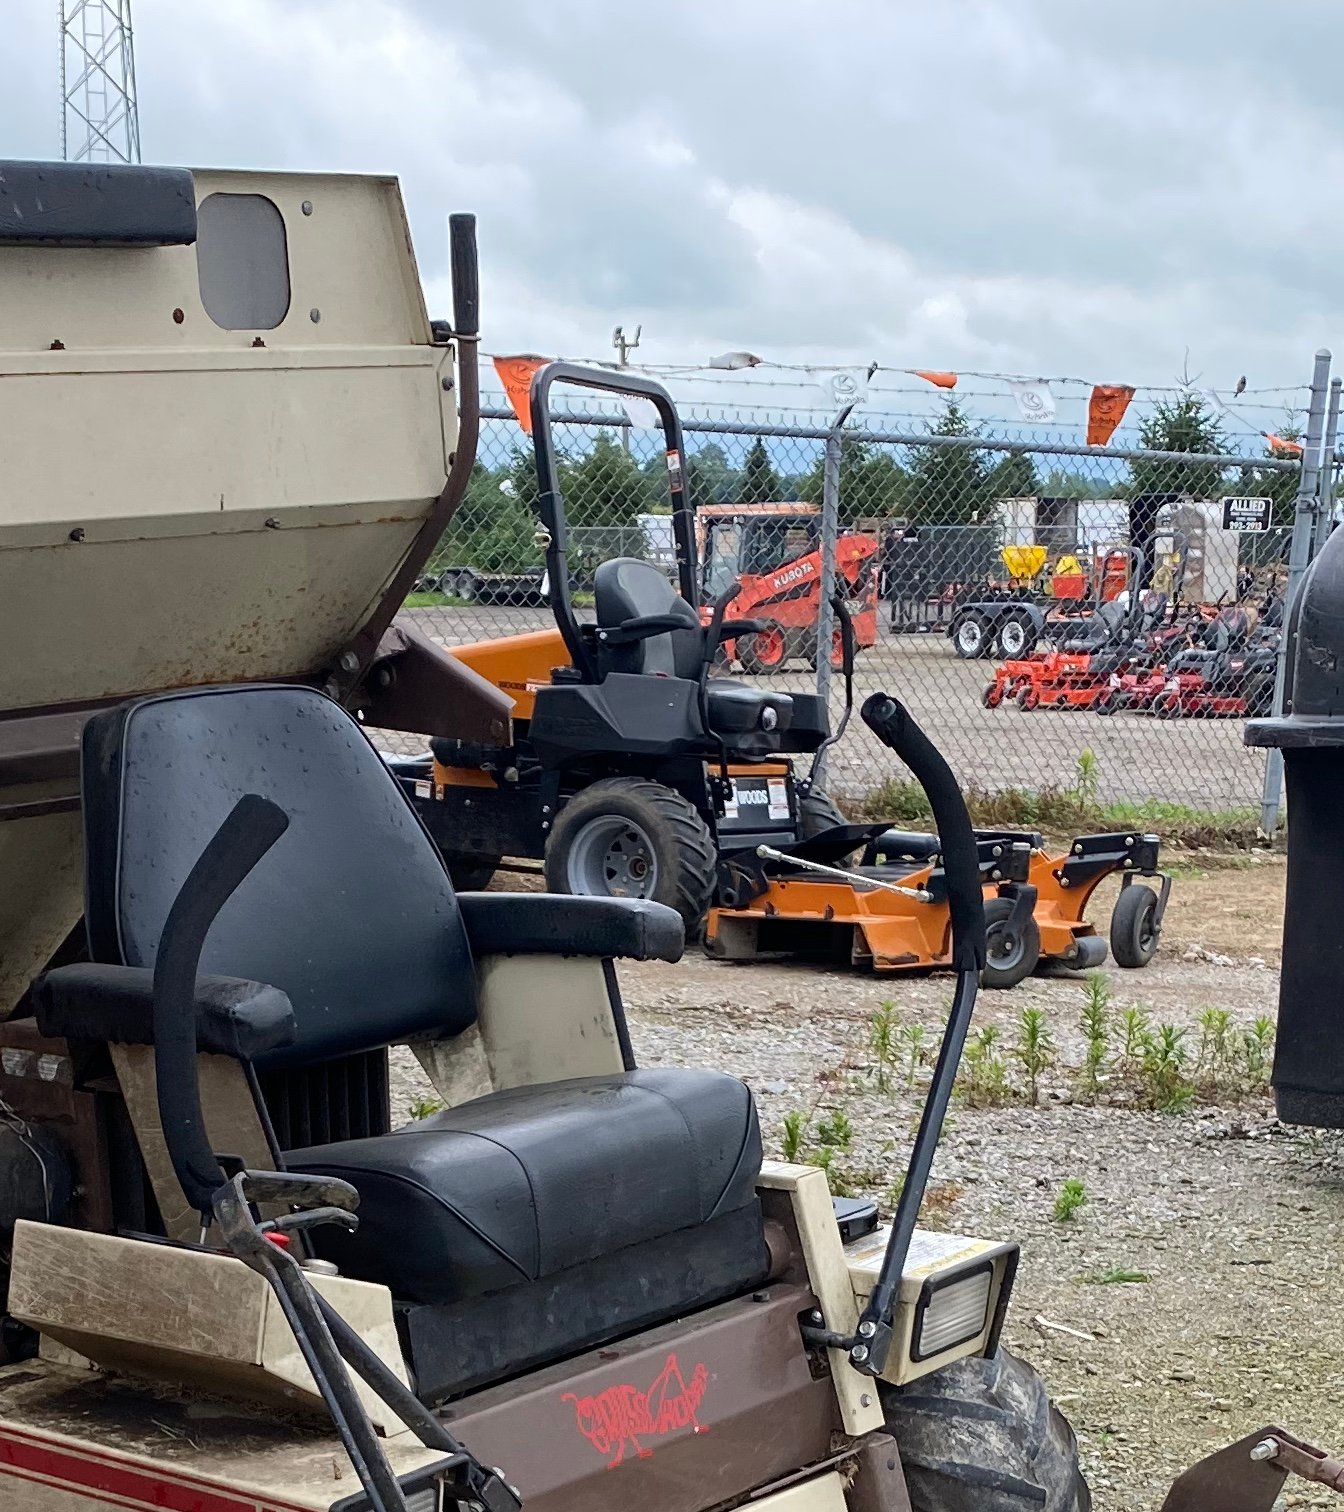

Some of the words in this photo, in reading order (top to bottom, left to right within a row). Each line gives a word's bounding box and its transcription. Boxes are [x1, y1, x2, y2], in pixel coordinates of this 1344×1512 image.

[1229, 499, 1266, 512] ALLIED
[773, 561, 815, 588] KUBOTA
[737, 789, 769, 805] WOODS
